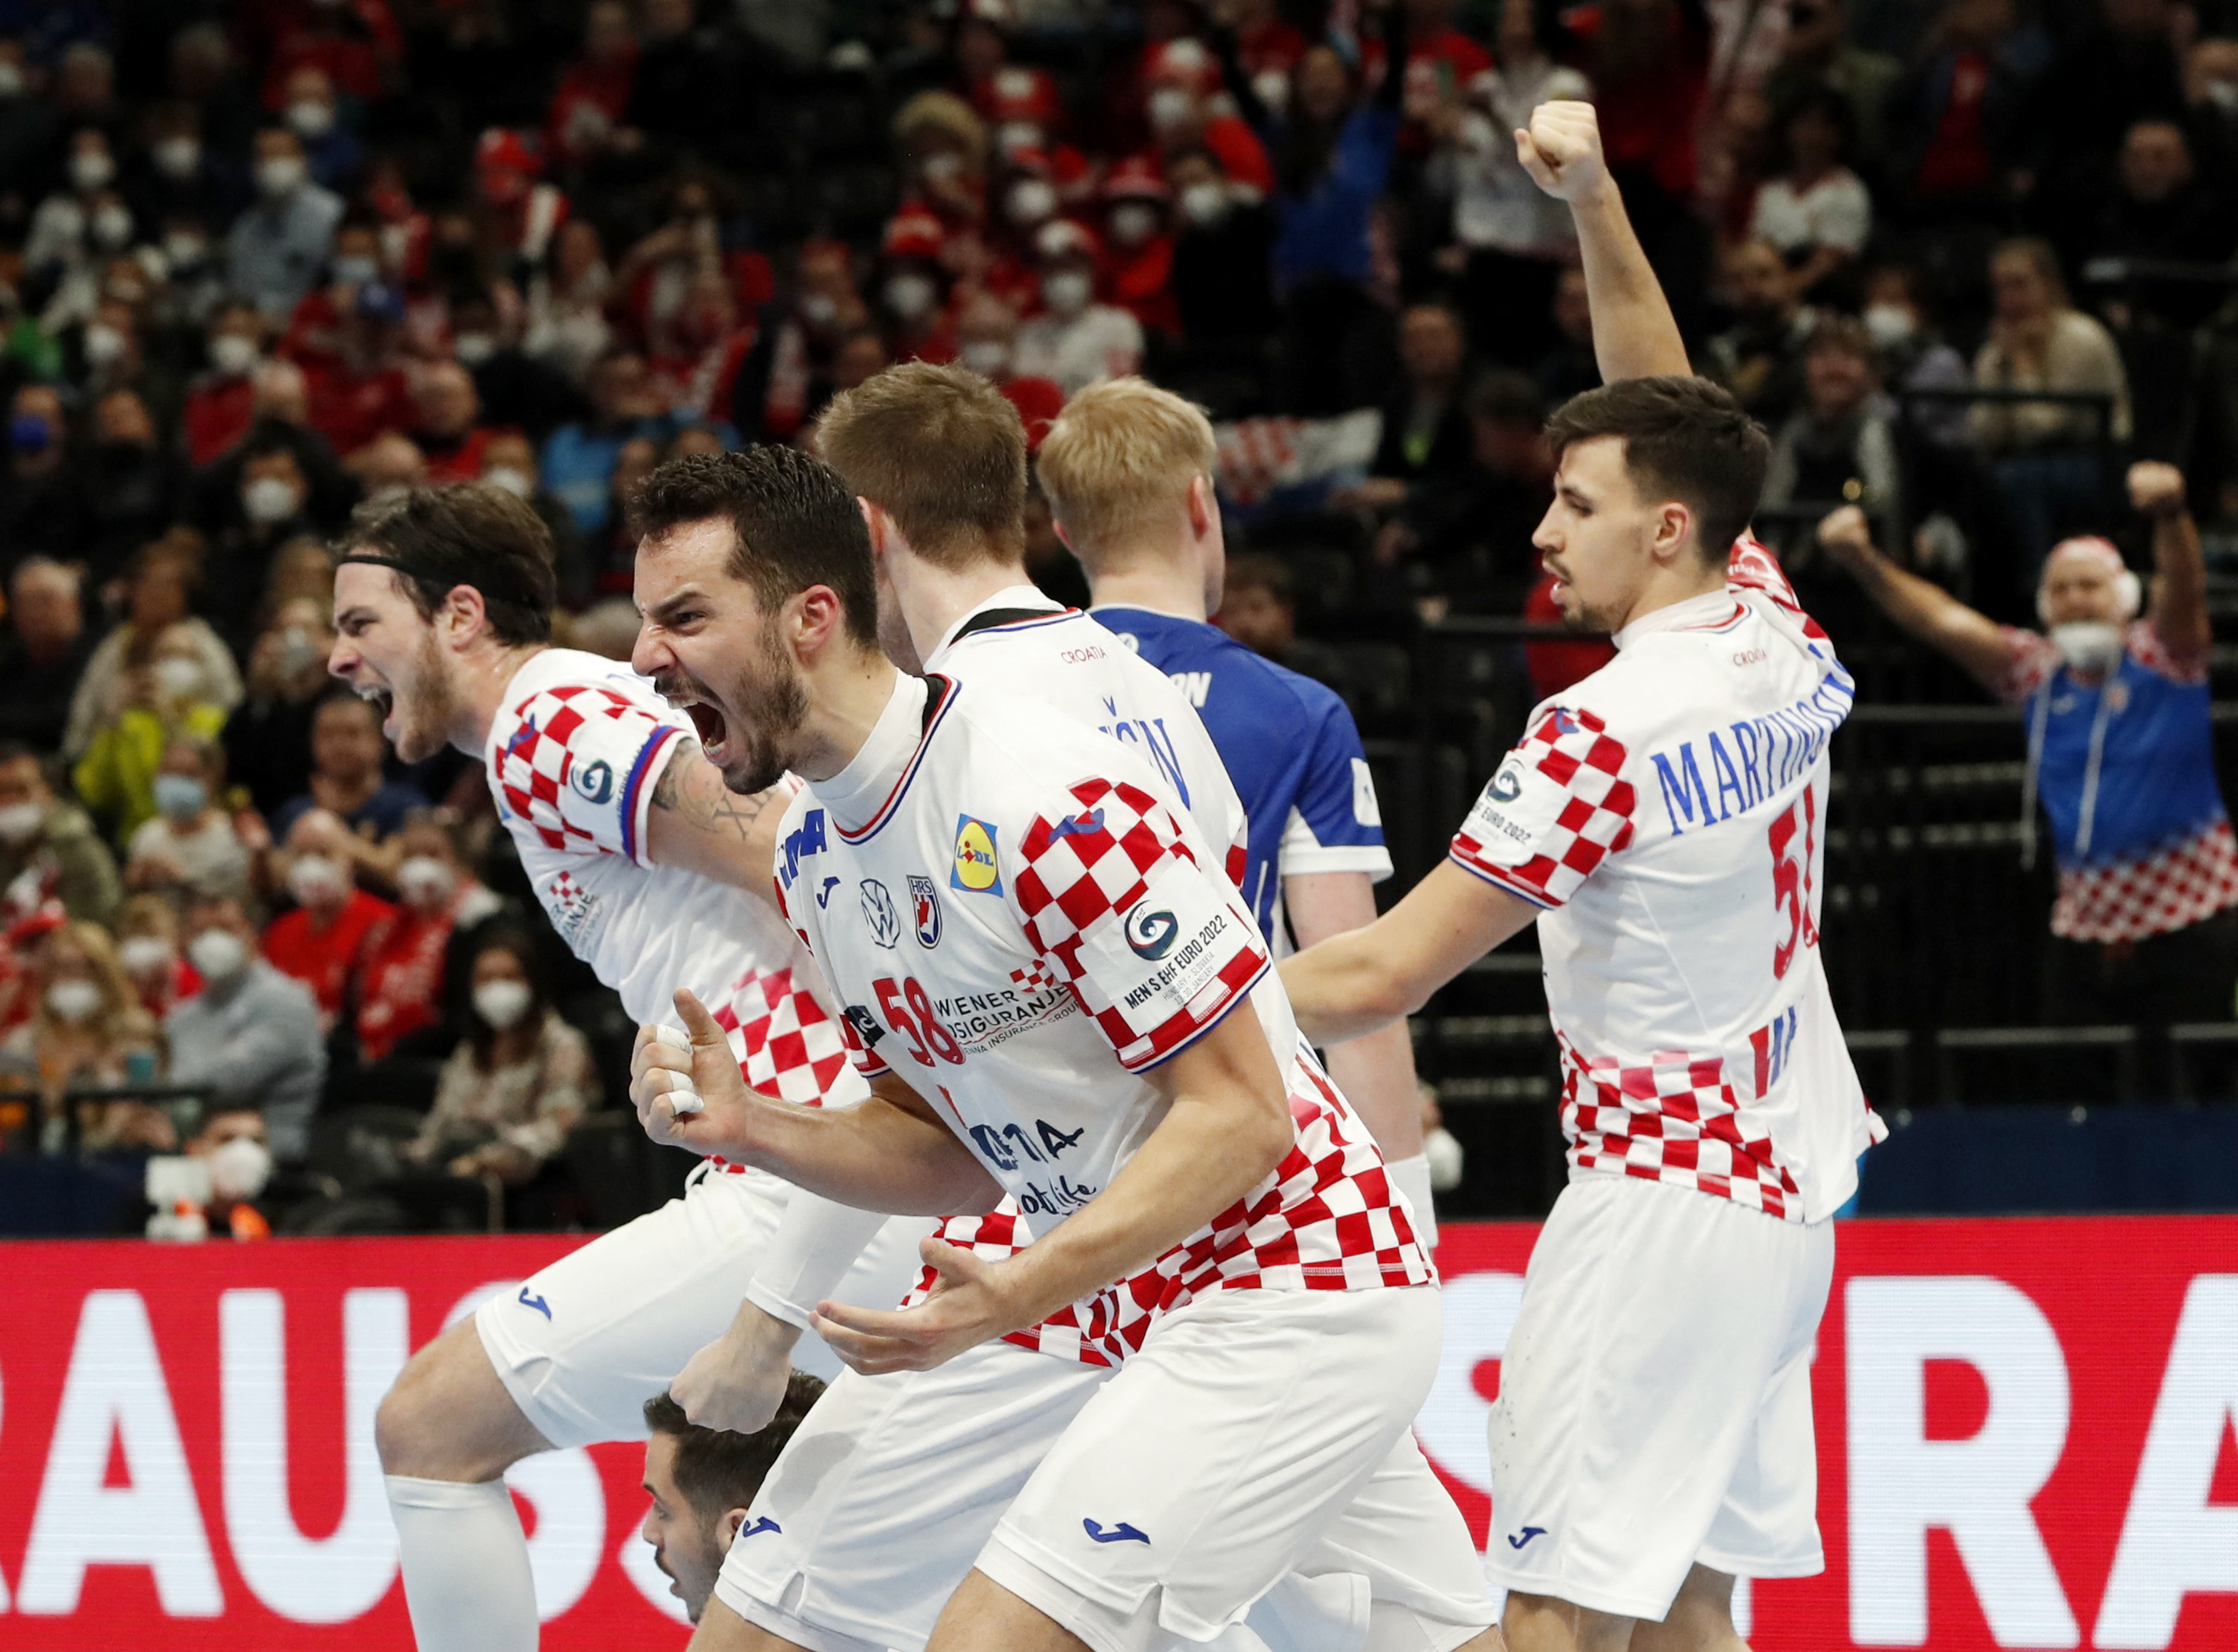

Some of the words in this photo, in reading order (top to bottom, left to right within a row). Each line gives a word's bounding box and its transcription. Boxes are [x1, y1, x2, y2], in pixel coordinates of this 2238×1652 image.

[1060, 645, 1107, 665] CROATIA
[911, 878, 933, 895] HRS
[1123, 977, 1162, 1010] MEN'S
[1155, 963, 1180, 986] EHF
[1174, 938, 1204, 970] EURO
[1199, 914, 1228, 947] 2022
[933, 989, 1020, 1018] WIENER
[872, 976, 966, 1067] 58
